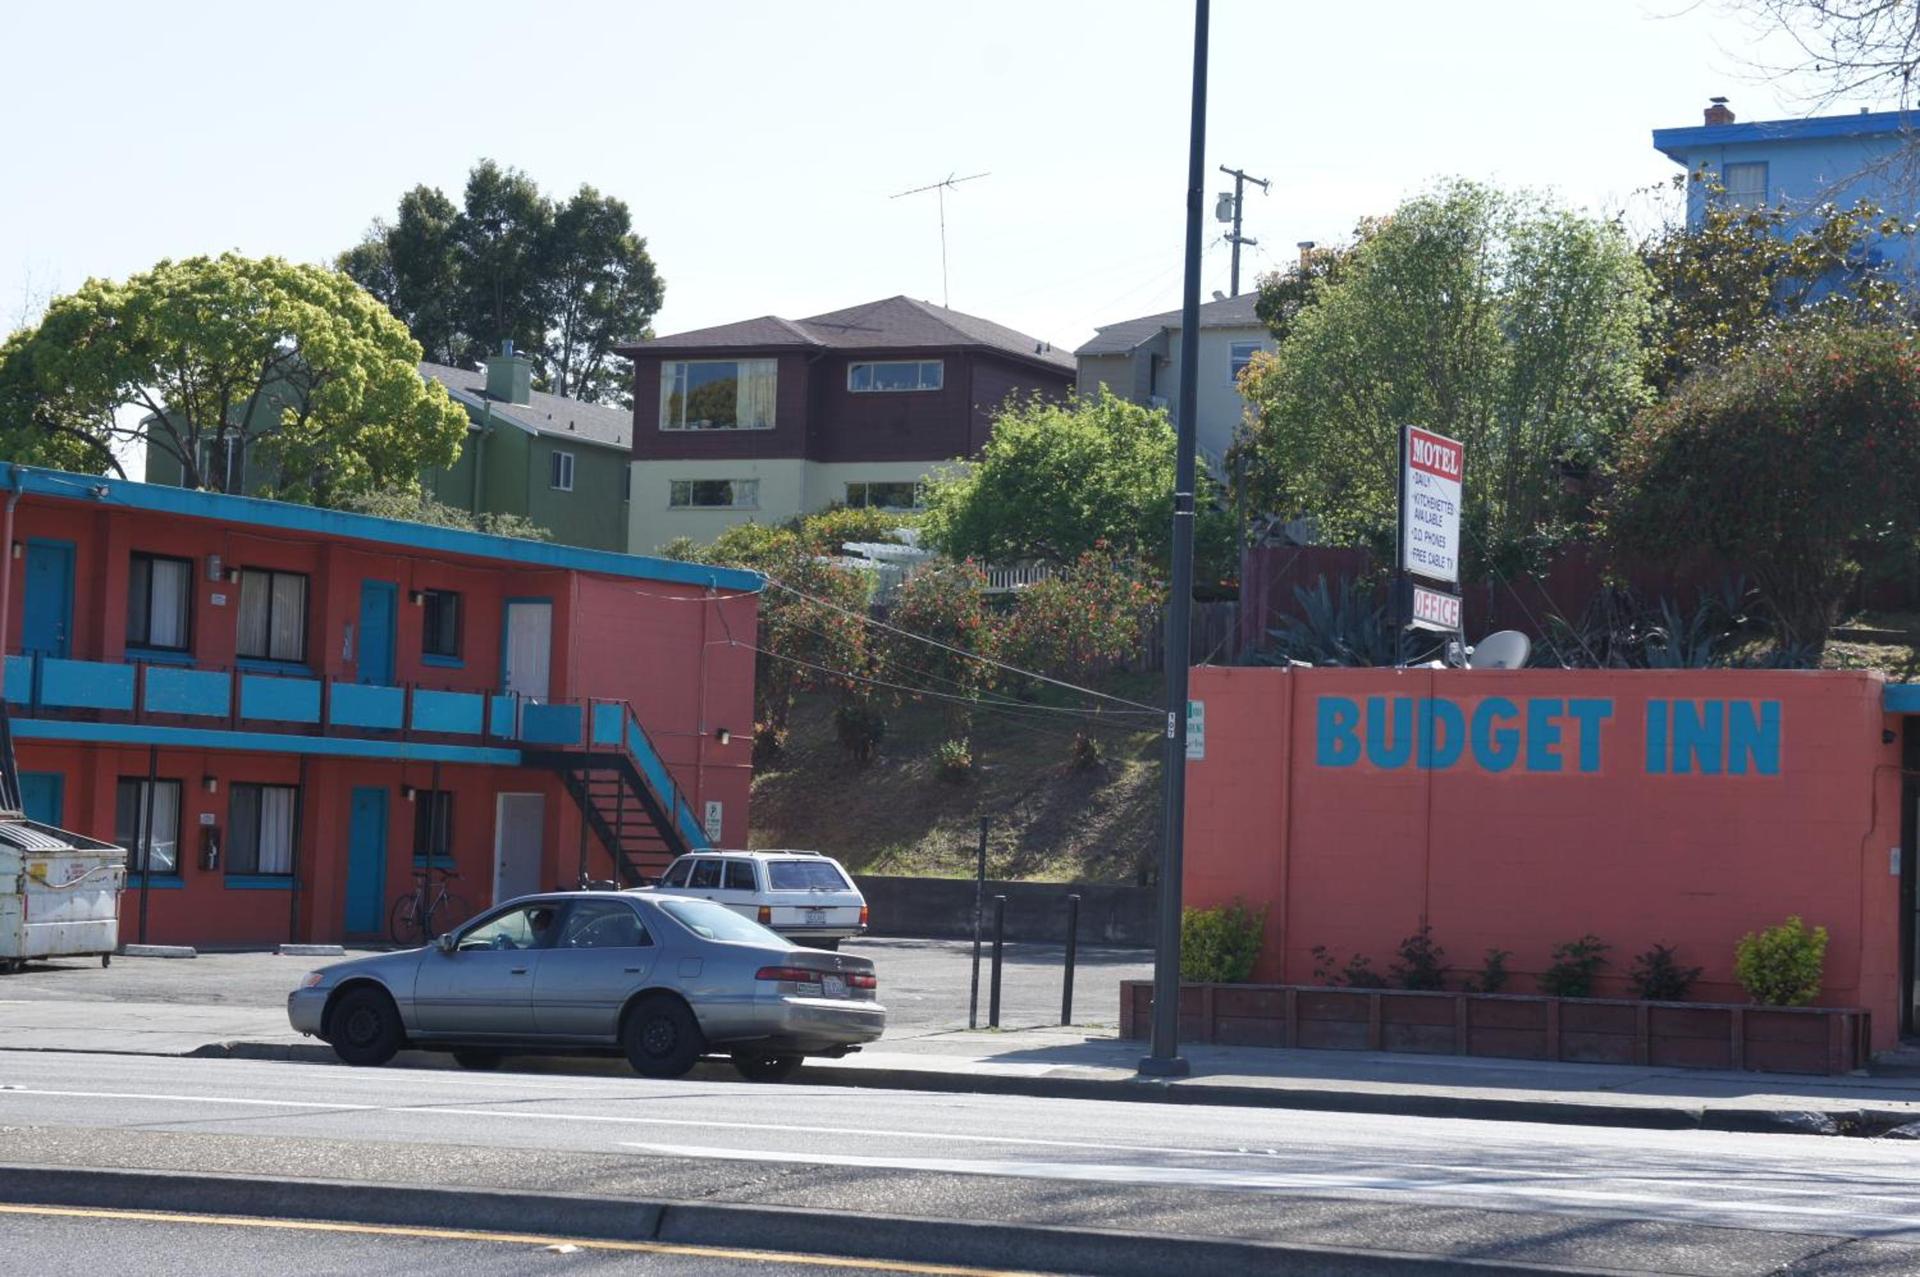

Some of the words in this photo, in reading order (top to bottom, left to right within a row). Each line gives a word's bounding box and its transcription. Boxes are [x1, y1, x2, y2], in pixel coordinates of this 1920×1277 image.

[1412, 437, 1458, 475] MOTEL
[1414, 507, 1443, 528] AVAILABLE
[1425, 530, 1446, 549] PHONES
[1413, 547, 1426, 563] FREE
[1428, 552, 1445, 568] CABLE
[1447, 557, 1453, 571] TV
[1415, 591, 1458, 625] OFFICE
[1316, 696, 1613, 773] BUDGET
[1646, 699, 1780, 775] INN
